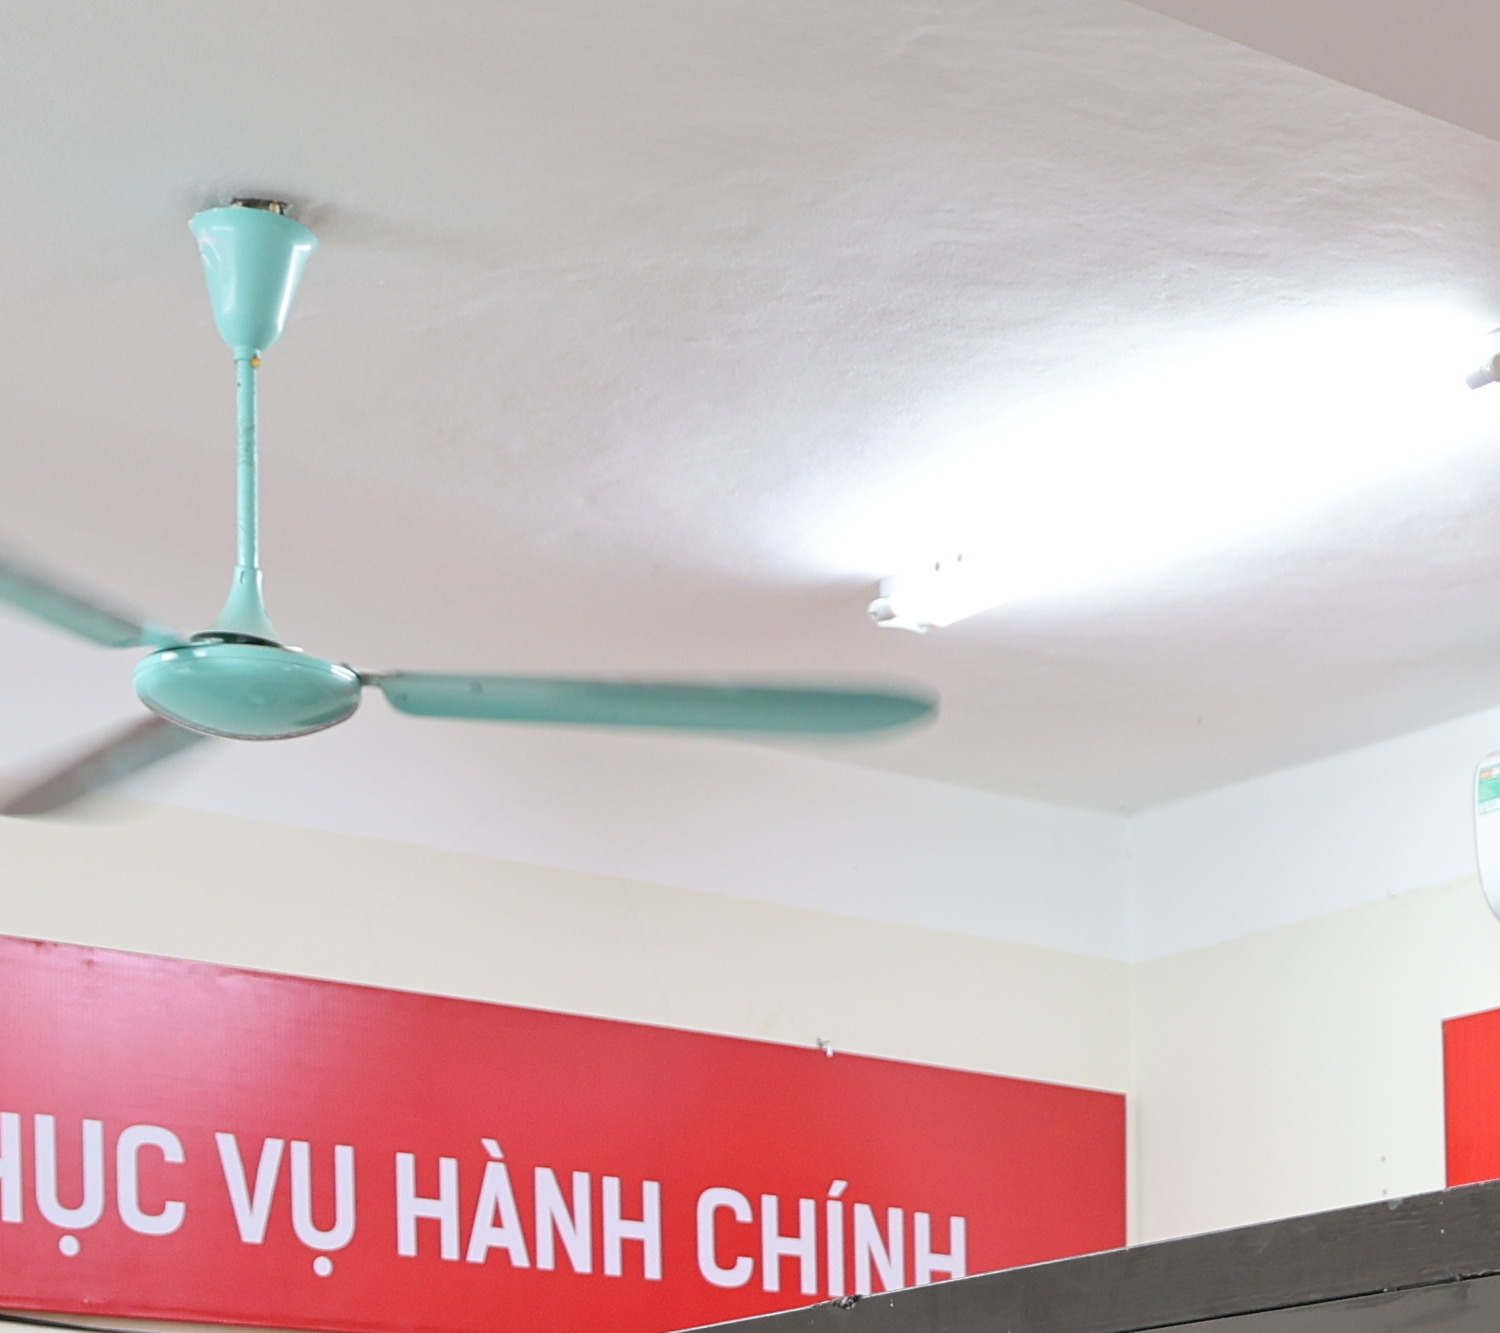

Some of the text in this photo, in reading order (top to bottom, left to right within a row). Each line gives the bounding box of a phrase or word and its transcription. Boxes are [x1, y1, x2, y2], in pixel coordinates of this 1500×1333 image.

[214, 1131, 357, 1279] VỤ
[394, 1139, 663, 1281] HÀNH
[696, 1181, 967, 1297] CHÍNH
